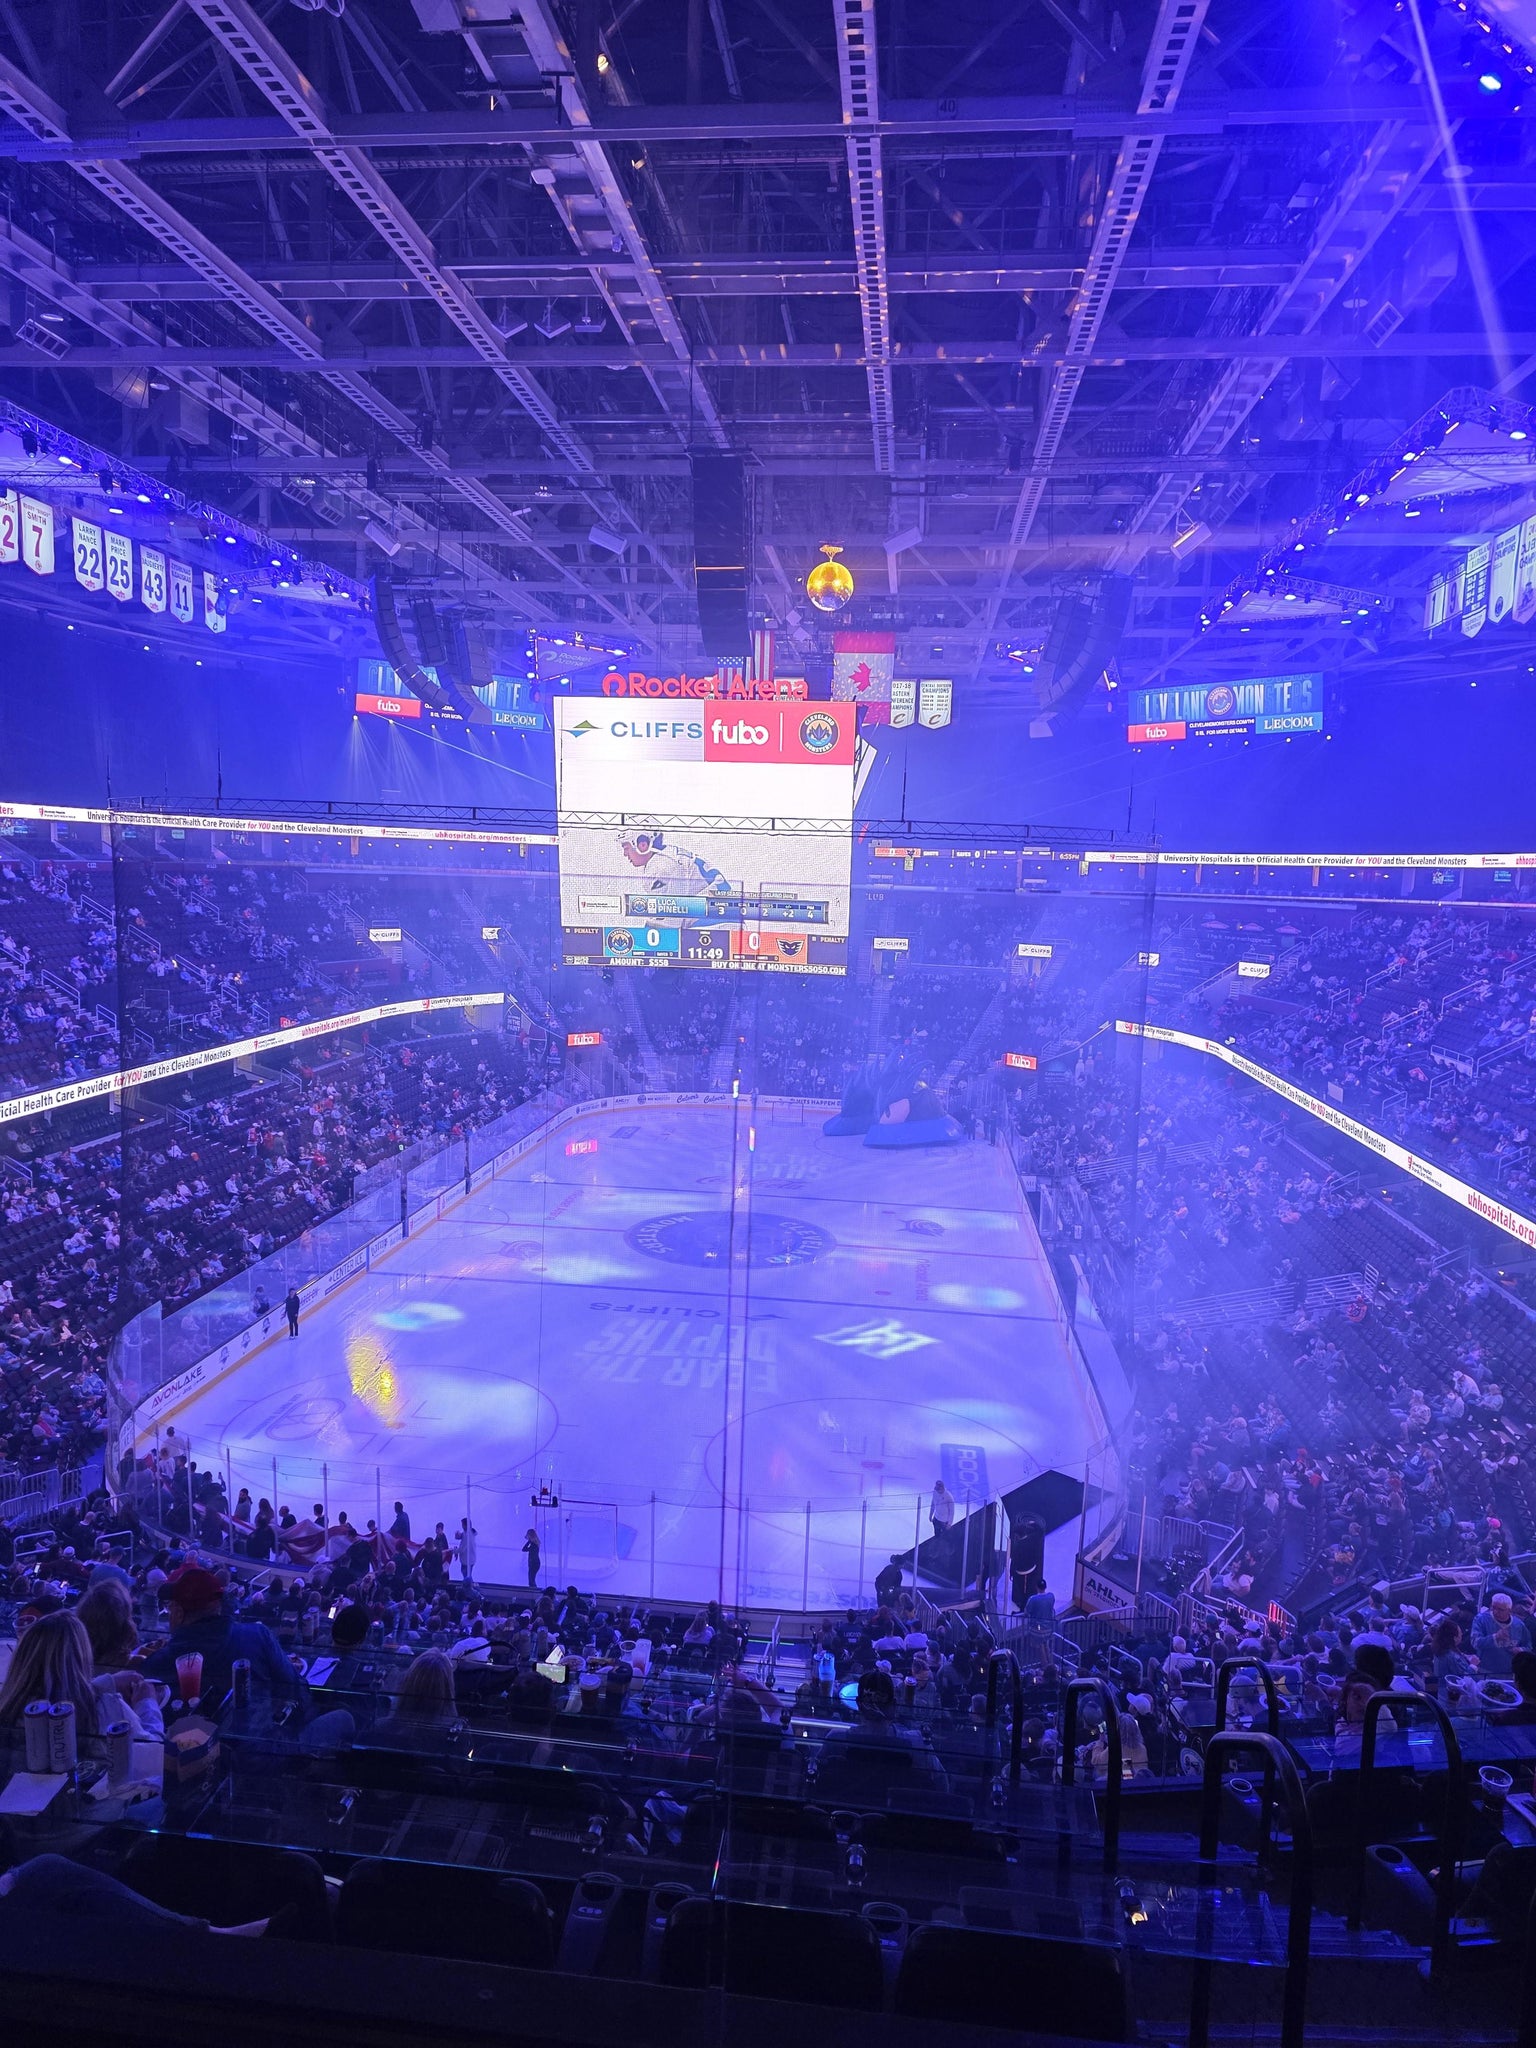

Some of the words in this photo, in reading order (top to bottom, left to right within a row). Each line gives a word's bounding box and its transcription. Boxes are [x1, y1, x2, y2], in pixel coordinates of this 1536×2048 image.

[27, 511, 47, 526] SMITH
[79, 523, 96, 537] LARRY
[32, 524, 43, 558] 7
[79, 533, 97, 546] NANCE
[110, 536, 126, 548] MARK
[111, 545, 127, 557] PRICE
[78, 543, 101, 580] 22
[109, 555, 130, 590] 25
[144, 569, 164, 602] 43
[174, 582, 190, 612] 11
[628, 672, 720, 697] Rocket
[728, 674, 809, 699] Arena
[377, 699, 401, 713] fubo
[804, 714, 835, 726] CLEVELAND
[610, 720, 703, 739] CLIFFS
[711, 718, 770, 745] fubo
[1145, 727, 1168, 738] fubo
[202, 819, 218, 827] Care
[219, 820, 246, 829] Provider
[297, 824, 330, 833] Cleveland
[332, 826, 364, 834] Monsters
[434, 831, 527, 843] uhhospitals.org/monsters
[1163, 855, 1199, 863] University
[1200, 855, 1233, 864] Hospitals
[1234, 855, 1241, 863] is
[1242, 855, 1255, 863] the
[1256, 856, 1283, 864] Official
[1284, 856, 1305, 864] Health
[1323, 857, 1354, 865] Provider
[1355, 857, 1366, 865] for
[1382, 857, 1395, 865] and
[1395, 857, 1406, 865] the
[1406, 857, 1437, 865] Cleveland
[1437, 857, 1467, 865] Monsters
[657, 906, 689, 914] PINELLI
[718, 906, 725, 915] 3
[762, 907, 769, 917] 2
[782, 908, 795, 918] +2
[807, 909, 814, 919] 4
[646, 928, 660, 947] 0
[748, 932, 760, 951] 0
[820, 936, 845, 944] PENALTY
[688, 947, 724, 960] 11:49
[609, 958, 645, 967] AMOUNT:
[711, 961, 728, 969] BUY
[767, 963, 847, 976] MONSTERS5050.COM
[574, 1033, 594, 1045] fubo
[1013, 1055, 1031, 1067] fubo
[0, 1100, 21, 1119] icial
[23, 1093, 54, 1113] Health
[56, 1090, 75, 1104] Care
[77, 1079, 111, 1098] Provider
[143, 1068, 157, 1080] and
[158, 1064, 170, 1075] the
[171, 1055, 203, 1072] Cleveland
[203, 1049, 232, 1064] Monsters
[1325, 1109, 1334, 1122] and
[1333, 1112, 1341, 1127] the
[1341, 1118, 1363, 1139] Cleveland
[1363, 1129, 1386, 1153] Monsters
[636, 1214, 695, 1256] MONSTERS
[332, 1258, 354, 1282] CENTER
[354, 1251, 364, 1267] ICE
[588, 1301, 721, 1319] CLIFFS
[662, 1357, 779, 1394] FEAR
